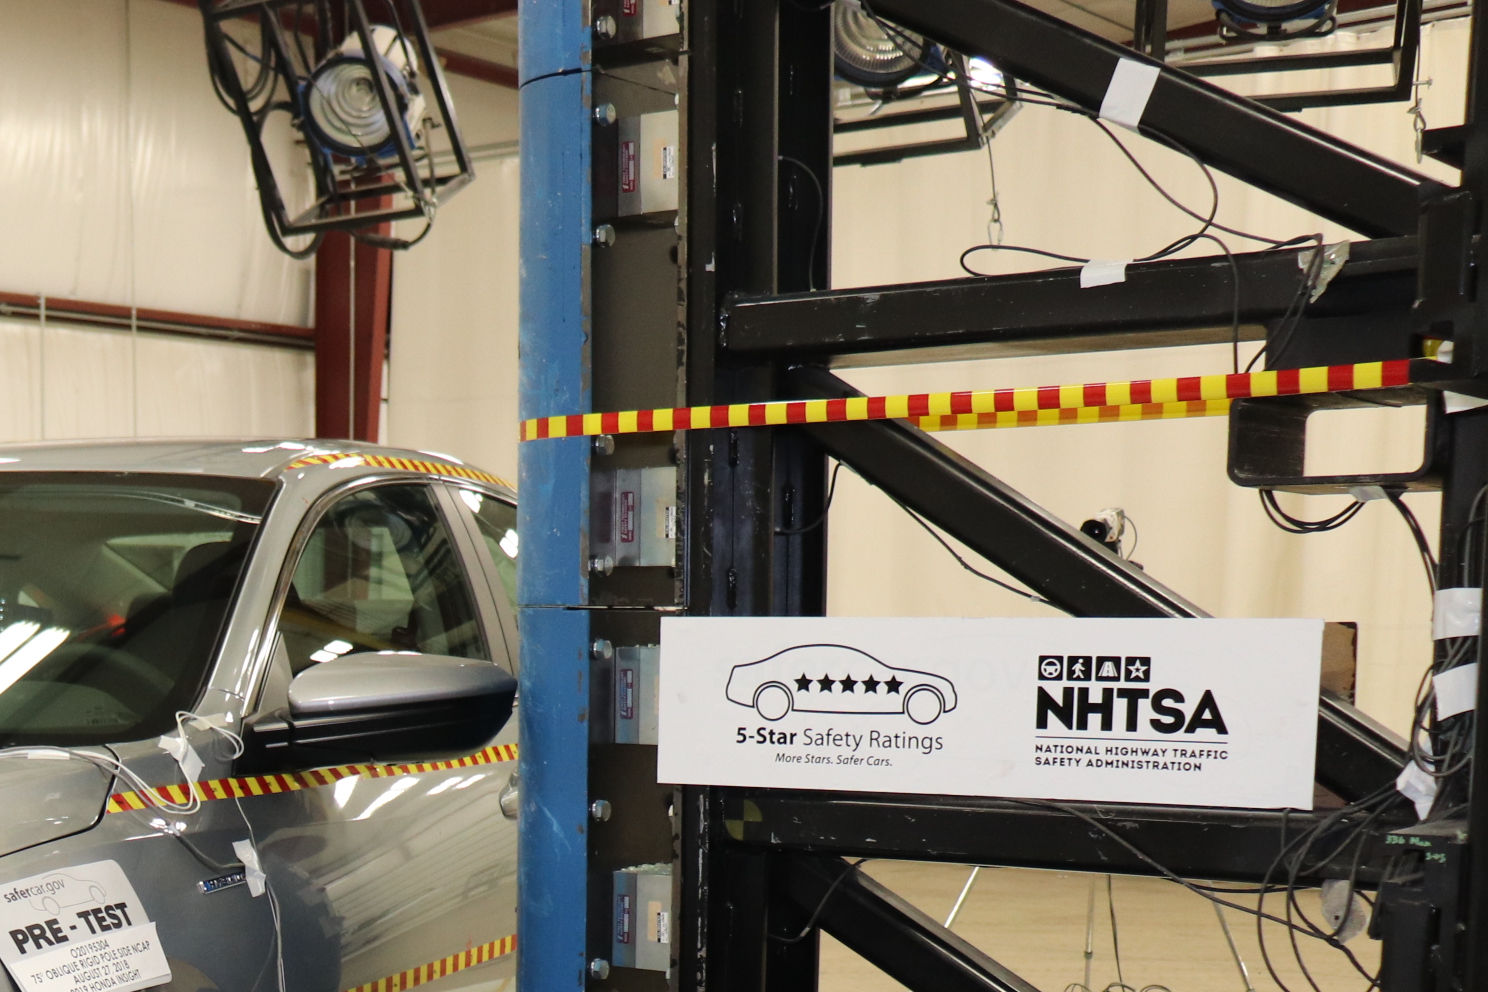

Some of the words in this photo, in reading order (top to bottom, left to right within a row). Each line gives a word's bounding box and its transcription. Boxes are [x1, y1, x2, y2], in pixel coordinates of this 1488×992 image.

[1035, 685, 1228, 736] NHTSA
[736, 727, 798, 748] 5-Star
[802, 727, 863, 752] Safety
[869, 730, 944, 755] Ratings
[1035, 744, 1100, 756] NATIONAL
[1105, 746, 1168, 758] HIGHWAY
[1172, 748, 1228, 760] TRAFFIC
[775, 753, 803, 765] More
[805, 753, 833, 765] Stars.
[836, 755, 865, 766] Safer
[867, 756, 893, 767] Cars.
[1035, 756, 1081, 768] SAFETY
[1086, 758, 1202, 772] ADMINISTRATION
[4, 878, 66, 903] safercar.gov
[9, 918, 70, 955] PRE
[76, 902, 133, 935] TEST
[45, 961, 80, 980] OBLIQUE
[79, 955, 101, 970] RIGID
[100, 950, 119, 963] POLE
[118, 945, 133, 958] SIDE
[132, 940, 151, 954] NCAP
[73, 967, 104, 985] AUGUST
[112, 959, 130, 973] 2018
[88, 977, 117, 992] HONDA
[117, 968, 142, 985] INSIGHT
